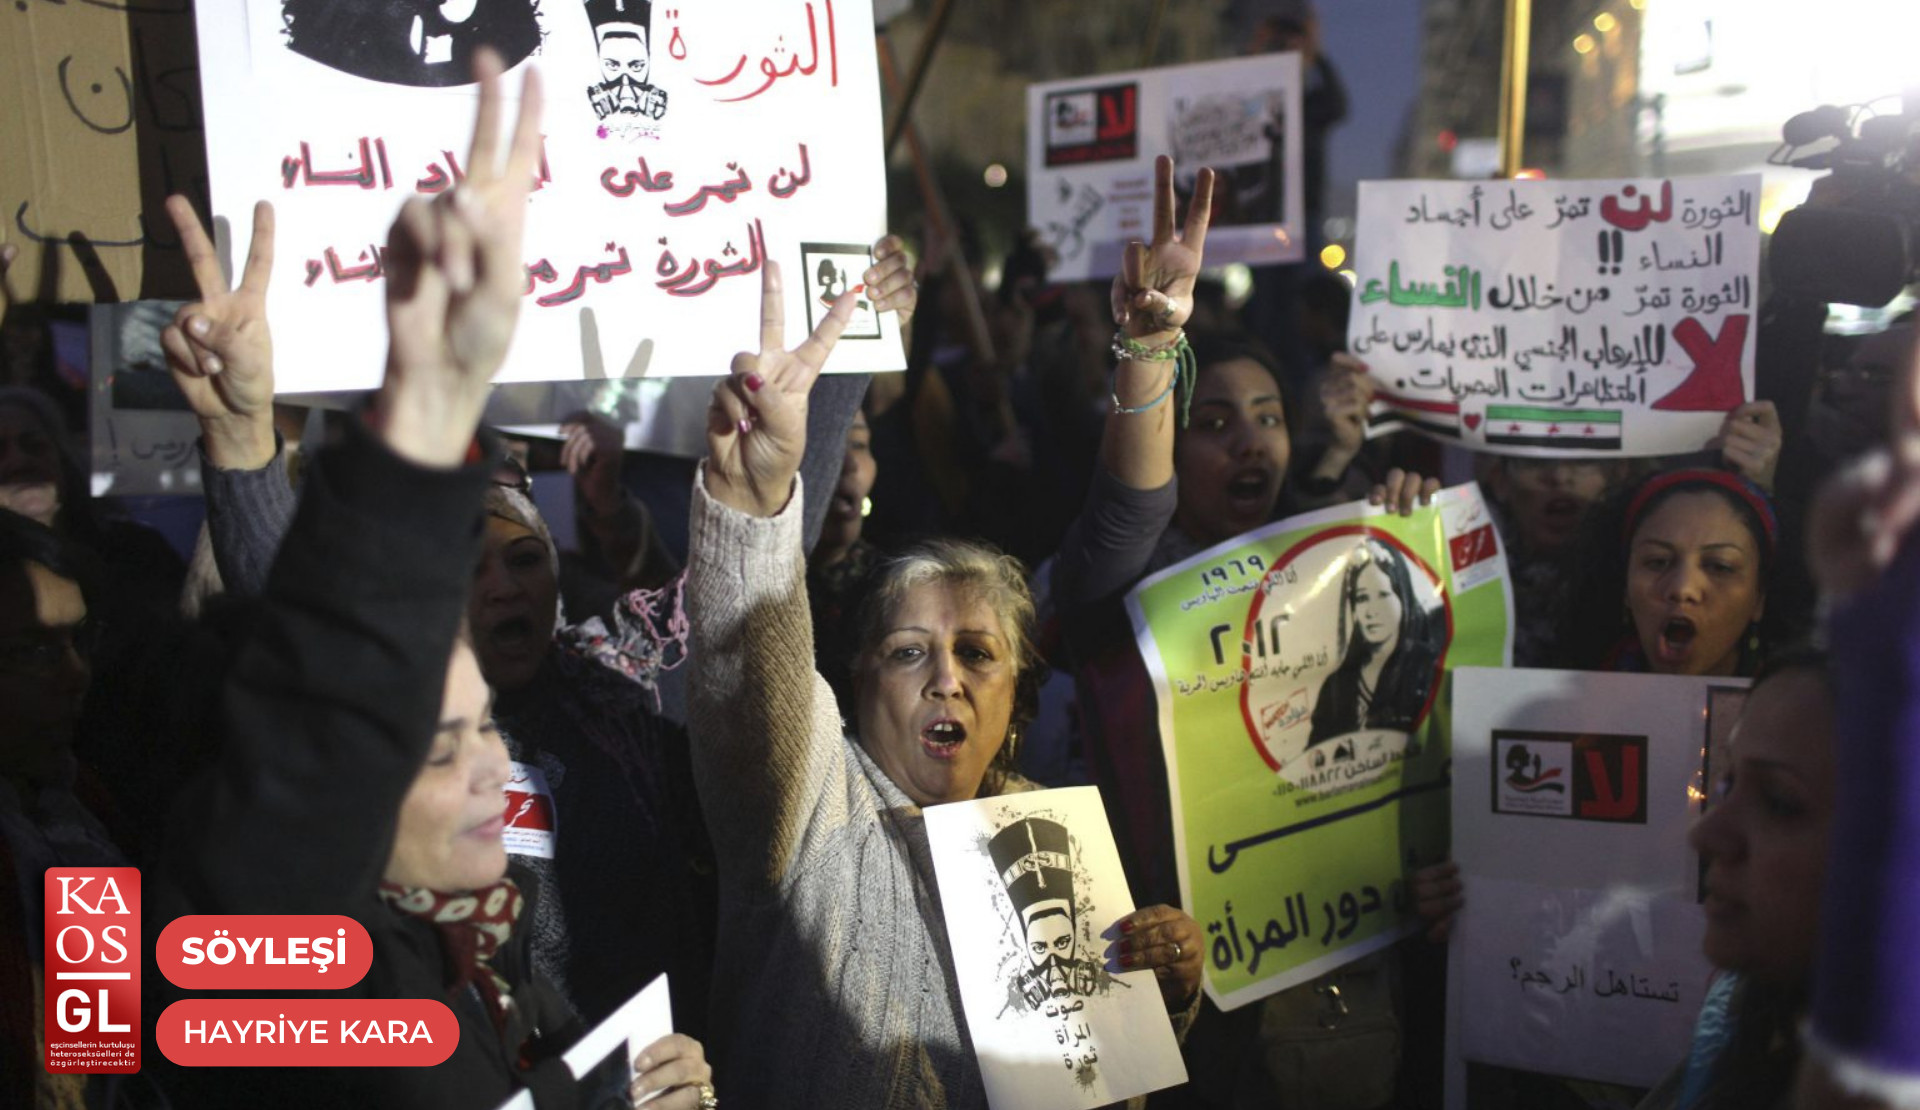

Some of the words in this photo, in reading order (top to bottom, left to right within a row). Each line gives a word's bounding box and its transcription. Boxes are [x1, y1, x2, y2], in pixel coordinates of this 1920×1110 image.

[665, 0, 838, 103] الثورة
[281, 136, 394, 190] النساء
[600, 156, 673, 197] على
[768, 142, 811, 198] لن
[663, 162, 752, 217] تمر
[1405, 185, 1484, 228] أجساد
[1489, 188, 1534, 230] على
[1600, 180, 1673, 232] لن
[1681, 189, 1752, 230] الثورة
[655, 217, 768, 297] الثورة
[1640, 231, 1723, 271] النساء
[535, 241, 633, 307] تمر
[1359, 258, 1483, 312] النساء
[1488, 273, 1563, 312] خلال
[1682, 274, 1750, 314] الثورة
[1565, 286, 1611, 315] من
[1353, 314, 1391, 355] على
[1201, 554, 1266, 587] ١٩٦٩
[1210, 613, 1290, 666] ٢٠١٢
[1580, 744, 1641, 820] لا
[1207, 892, 1310, 976] المرأة
[1321, 884, 1382, 947] دور
[1594, 970, 1680, 1004] تستاهل
[1045, 999, 1085, 1022] صوت
[1055, 1022, 1092, 1048] المرأة
[1064, 1045, 1099, 1071] ثورة
